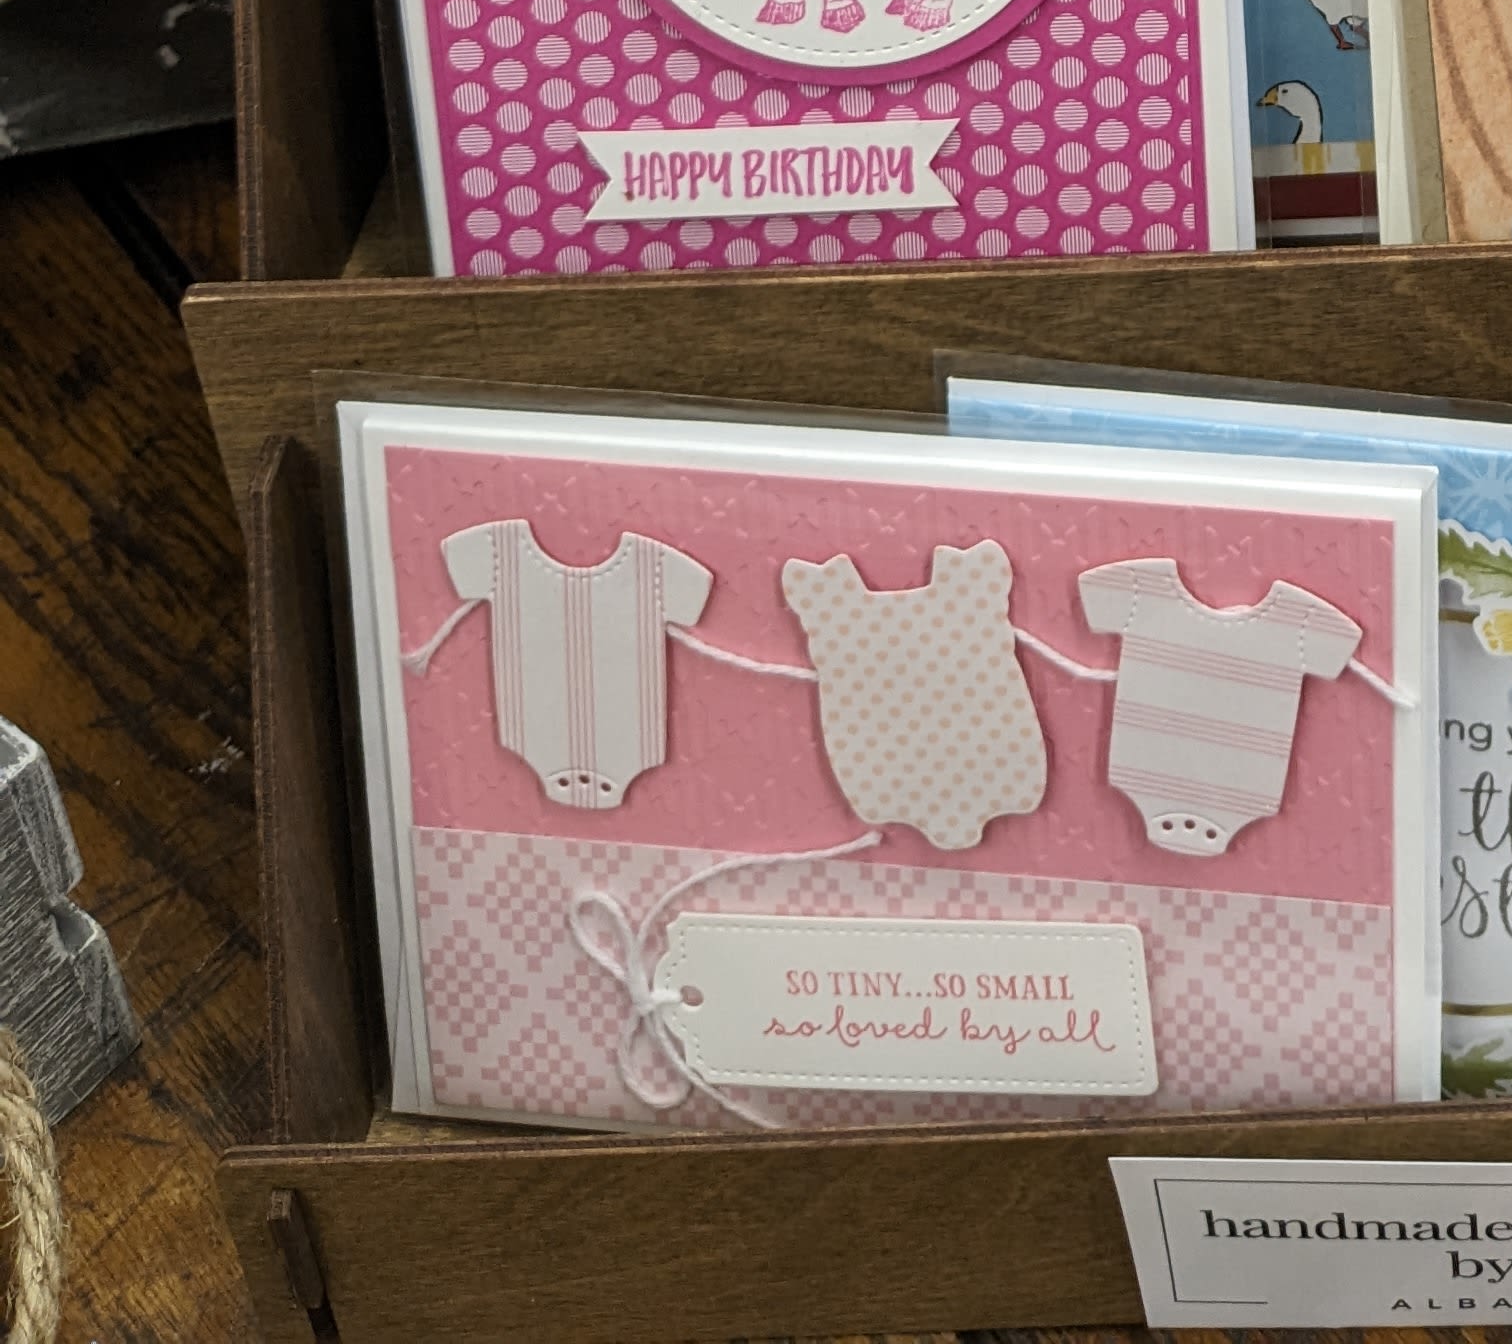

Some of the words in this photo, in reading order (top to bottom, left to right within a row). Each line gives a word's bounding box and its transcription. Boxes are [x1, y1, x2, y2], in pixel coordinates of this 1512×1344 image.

[623, 150, 733, 201] HAPPY
[741, 144, 914, 199] BIRTHDAY
[785, 969, 819, 996] SO
[977, 973, 1074, 1002] SMALL
[763, 1014, 824, 1038] so
[824, 1006, 948, 1048] loved
[960, 1008, 1034, 1054] by
[1038, 1008, 1117, 1052] all
